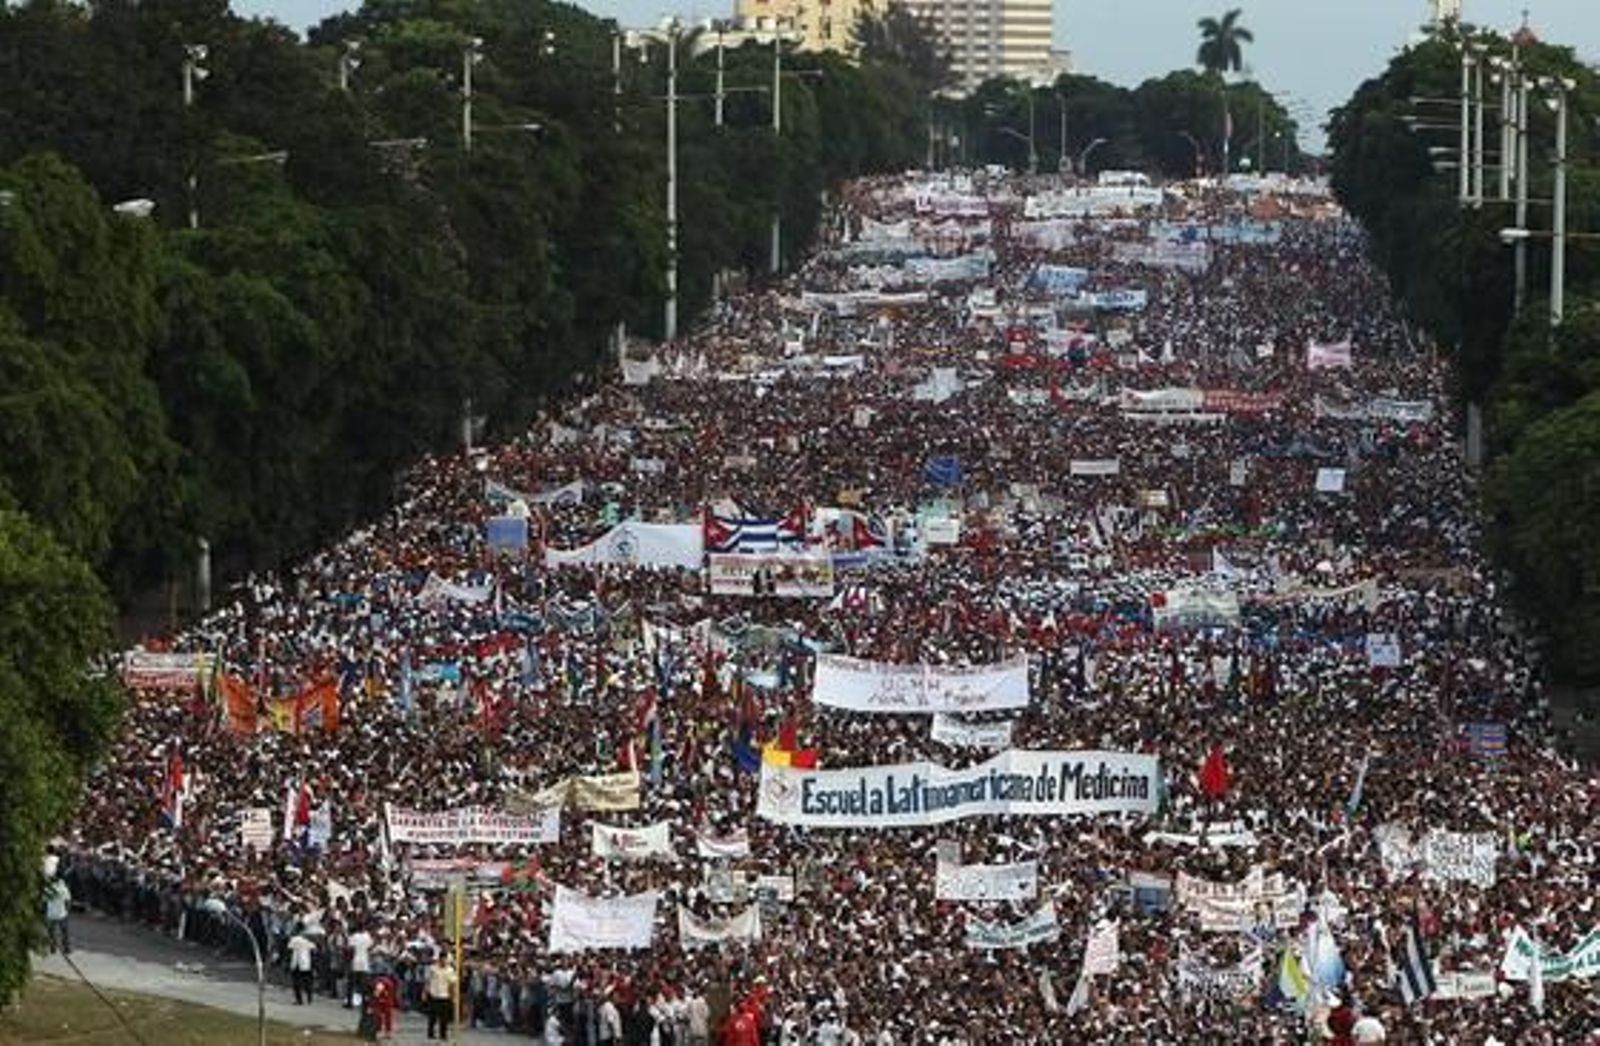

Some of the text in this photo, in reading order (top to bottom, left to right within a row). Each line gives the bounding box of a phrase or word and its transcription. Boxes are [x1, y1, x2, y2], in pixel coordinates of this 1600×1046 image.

[801, 761, 1149, 815] Escuela Latinoamericana de Medicina
